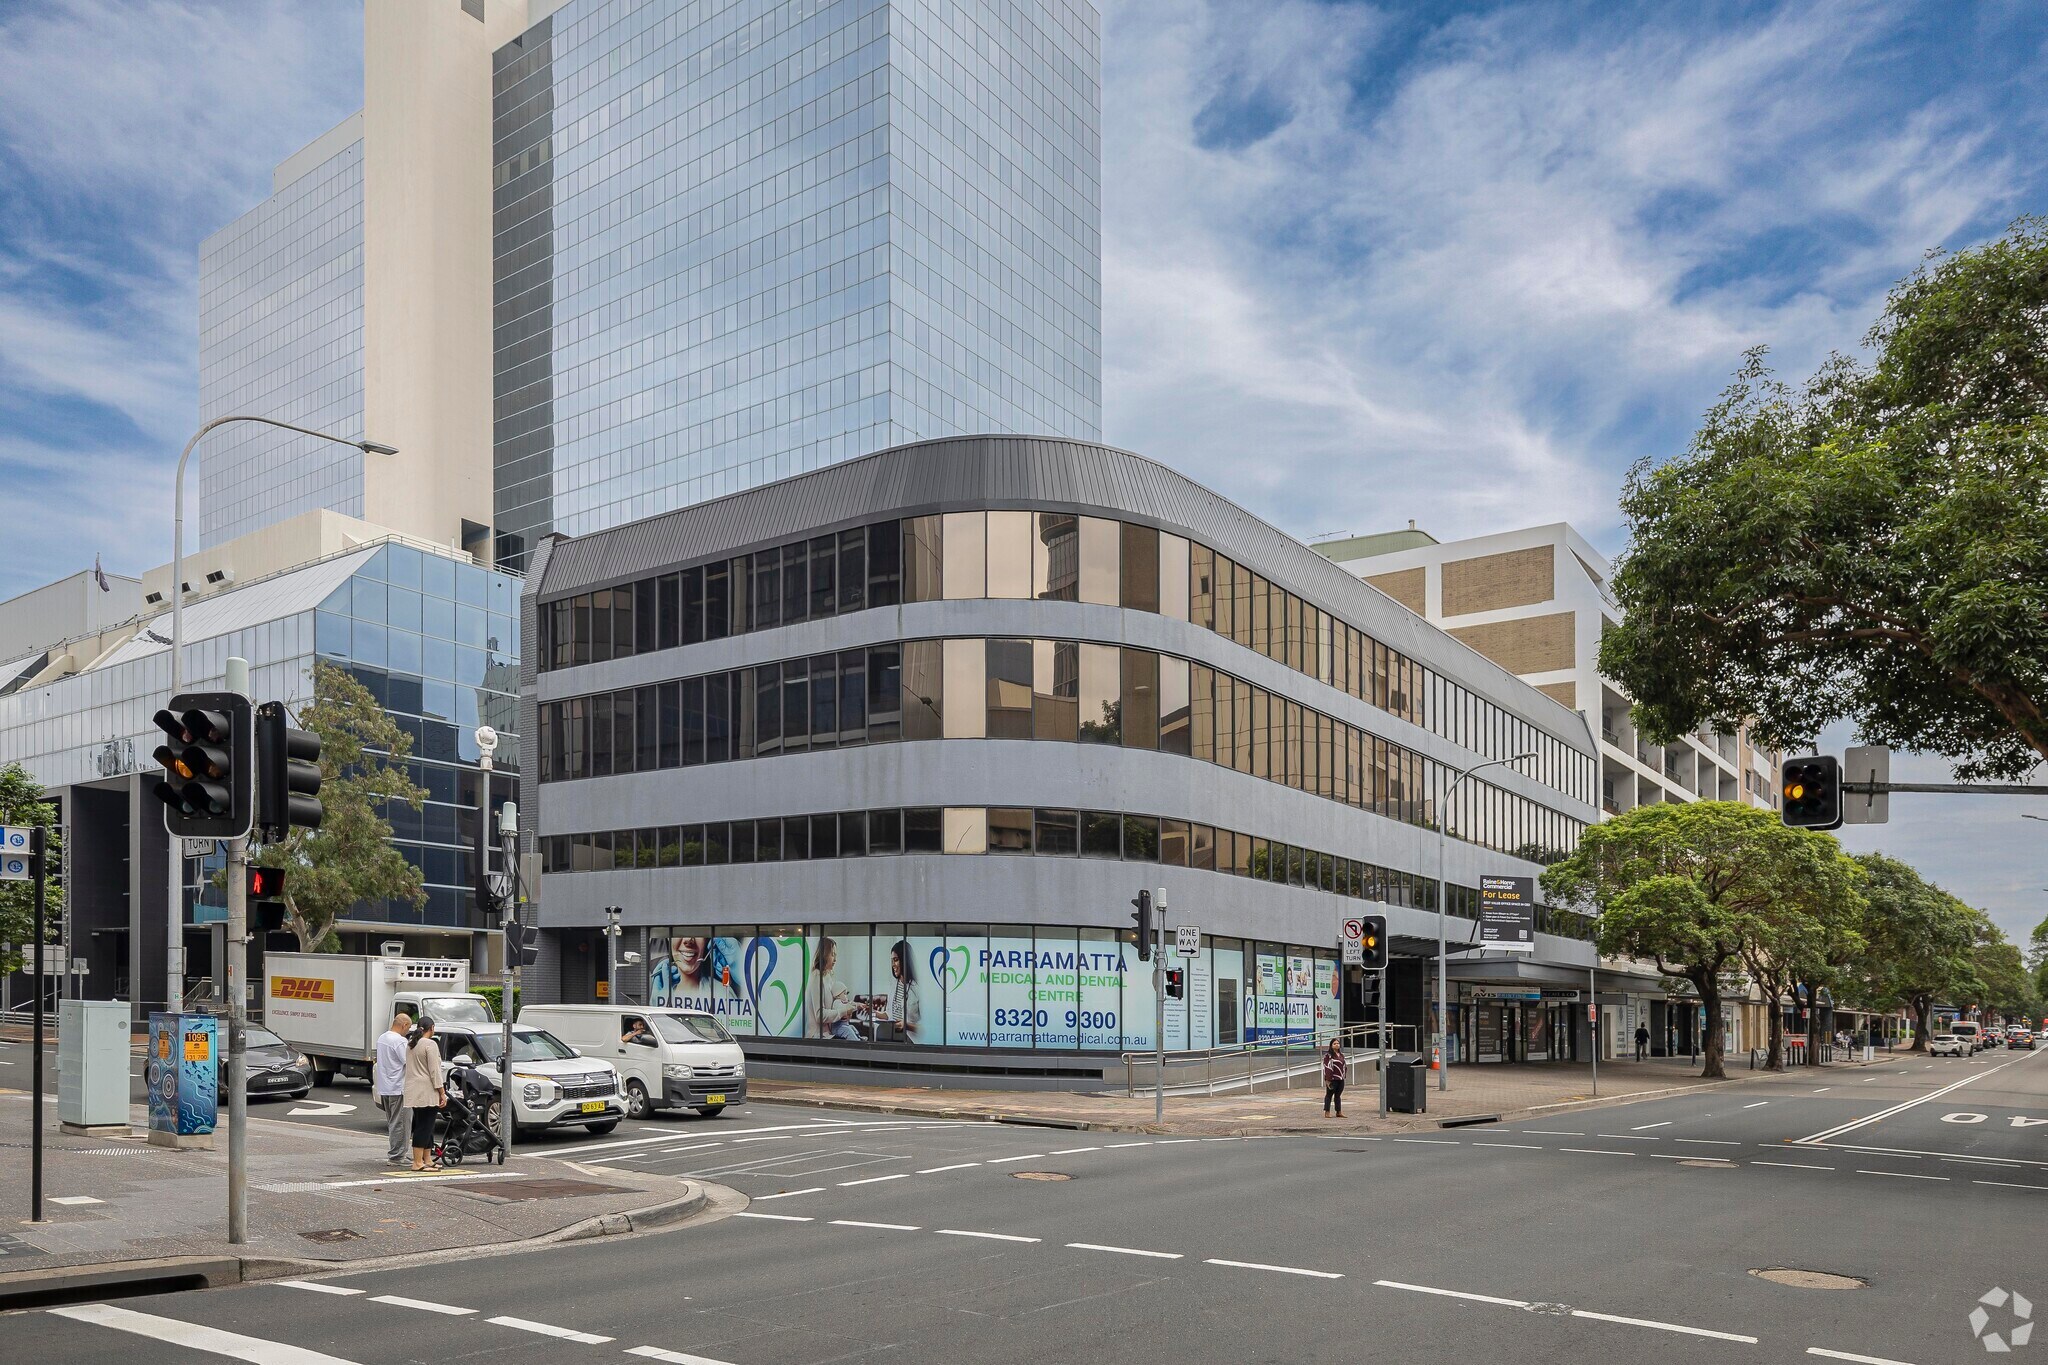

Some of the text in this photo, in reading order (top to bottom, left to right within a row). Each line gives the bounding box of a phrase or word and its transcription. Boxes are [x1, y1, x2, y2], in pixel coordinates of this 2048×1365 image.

[188, 839, 209, 849] TURN
[1483, 890, 1496, 898] For
[979, 949, 1128, 972] PARRAMATTA
[980, 972, 1127, 988] MEDICAL AND DENTAL
[280, 978, 325, 999] DHL
[1028, 990, 1083, 1002] CENTRE
[1259, 1001, 1309, 1015] PARRAMATTA
[994, 1008, 1116, 1029] 8320 9300
[188, 1033, 206, 1042] 1095
[958, 1030, 1147, 1045] www.parramattamedical.com.au
